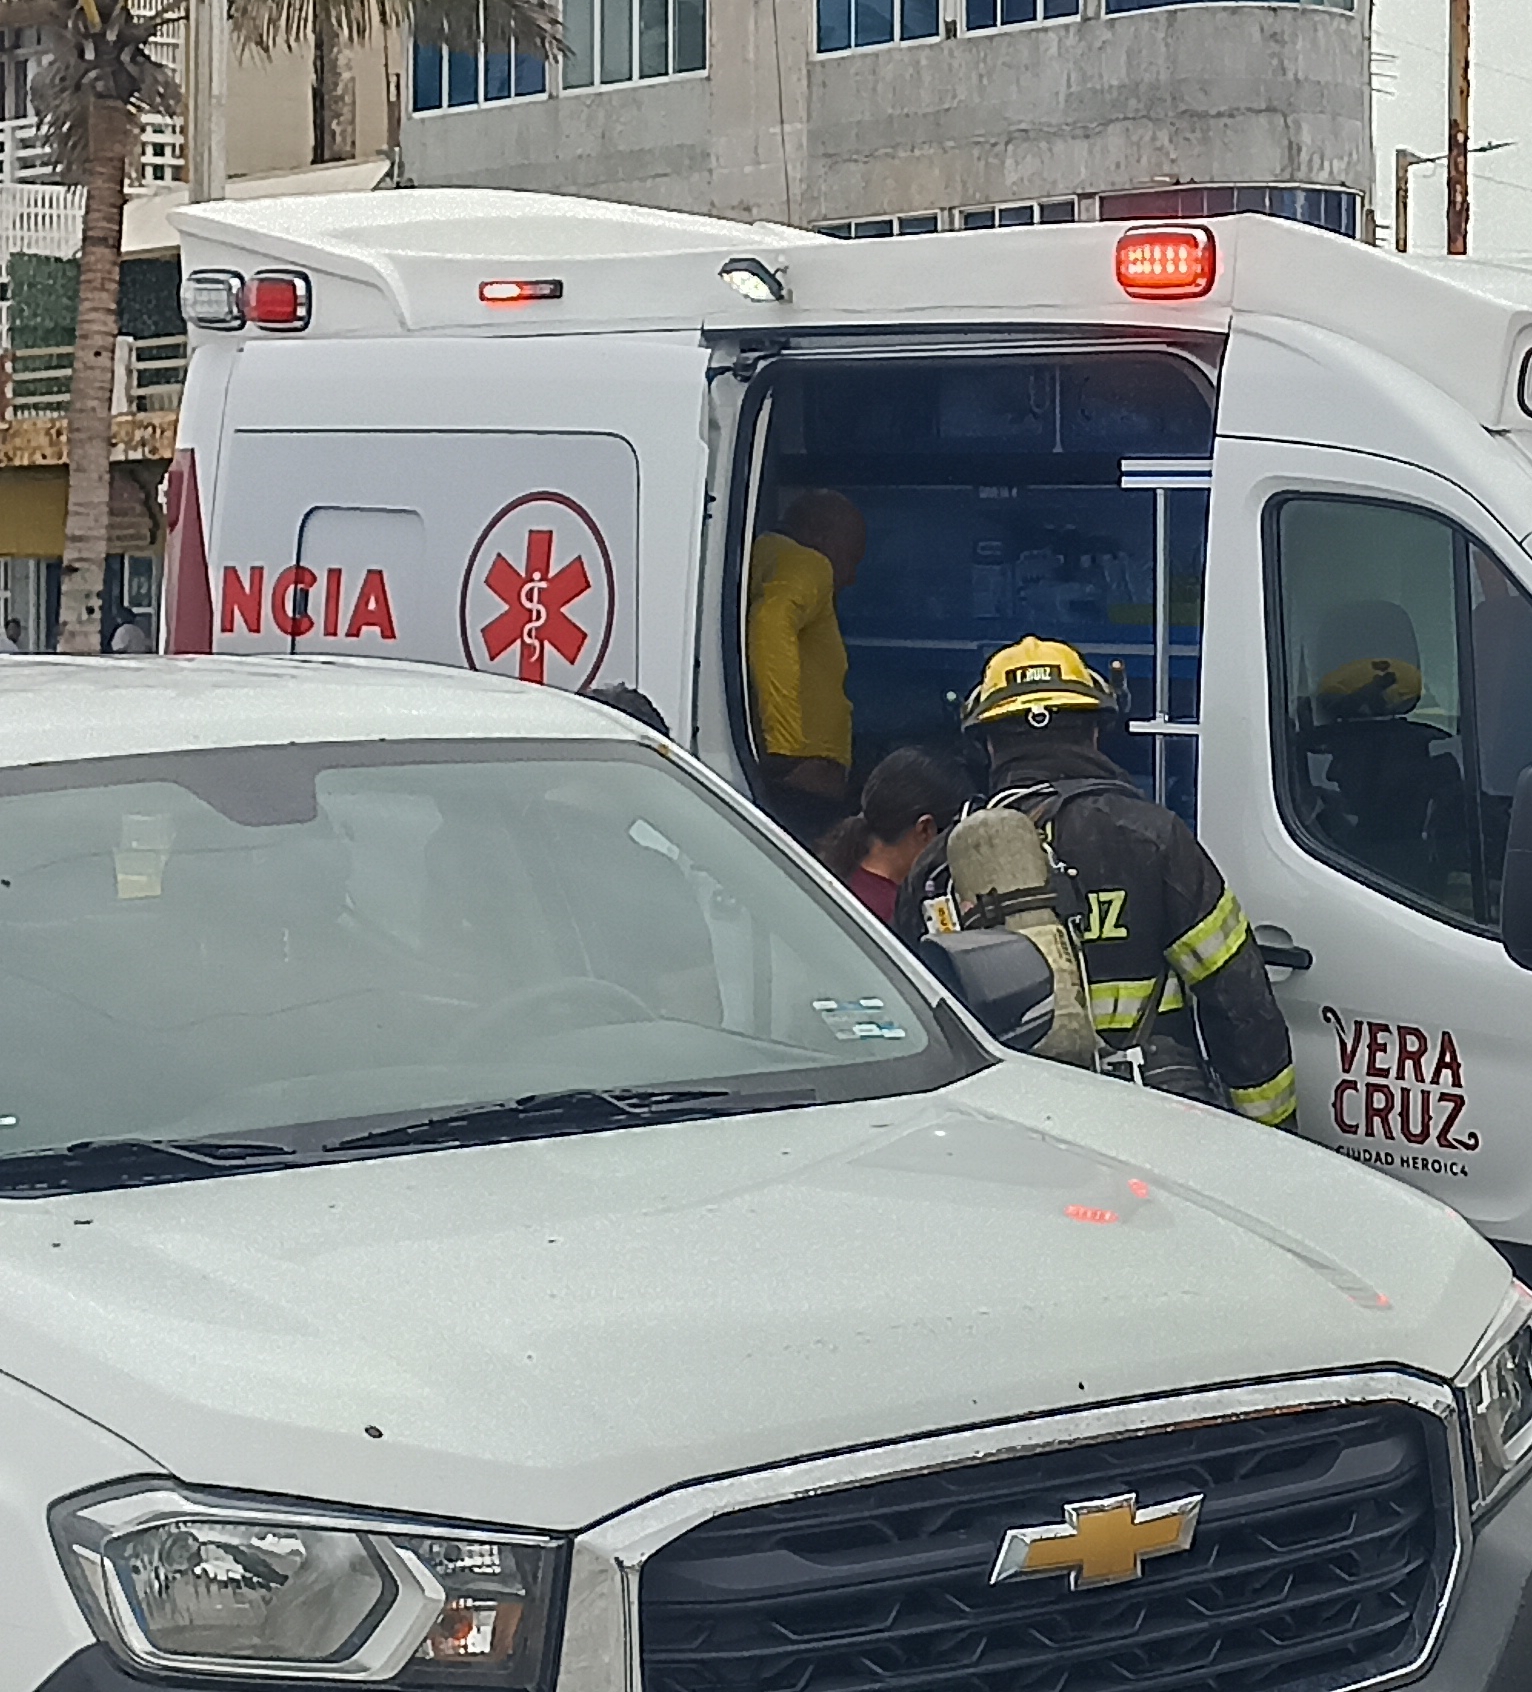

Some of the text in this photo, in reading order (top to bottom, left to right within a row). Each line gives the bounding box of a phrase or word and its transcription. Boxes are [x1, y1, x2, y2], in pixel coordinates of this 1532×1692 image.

[1321, 1005, 1464, 1089] VERA
[1331, 1078, 1480, 1151] CRUZ
[1335, 1144, 1395, 1167] CIUDAD
